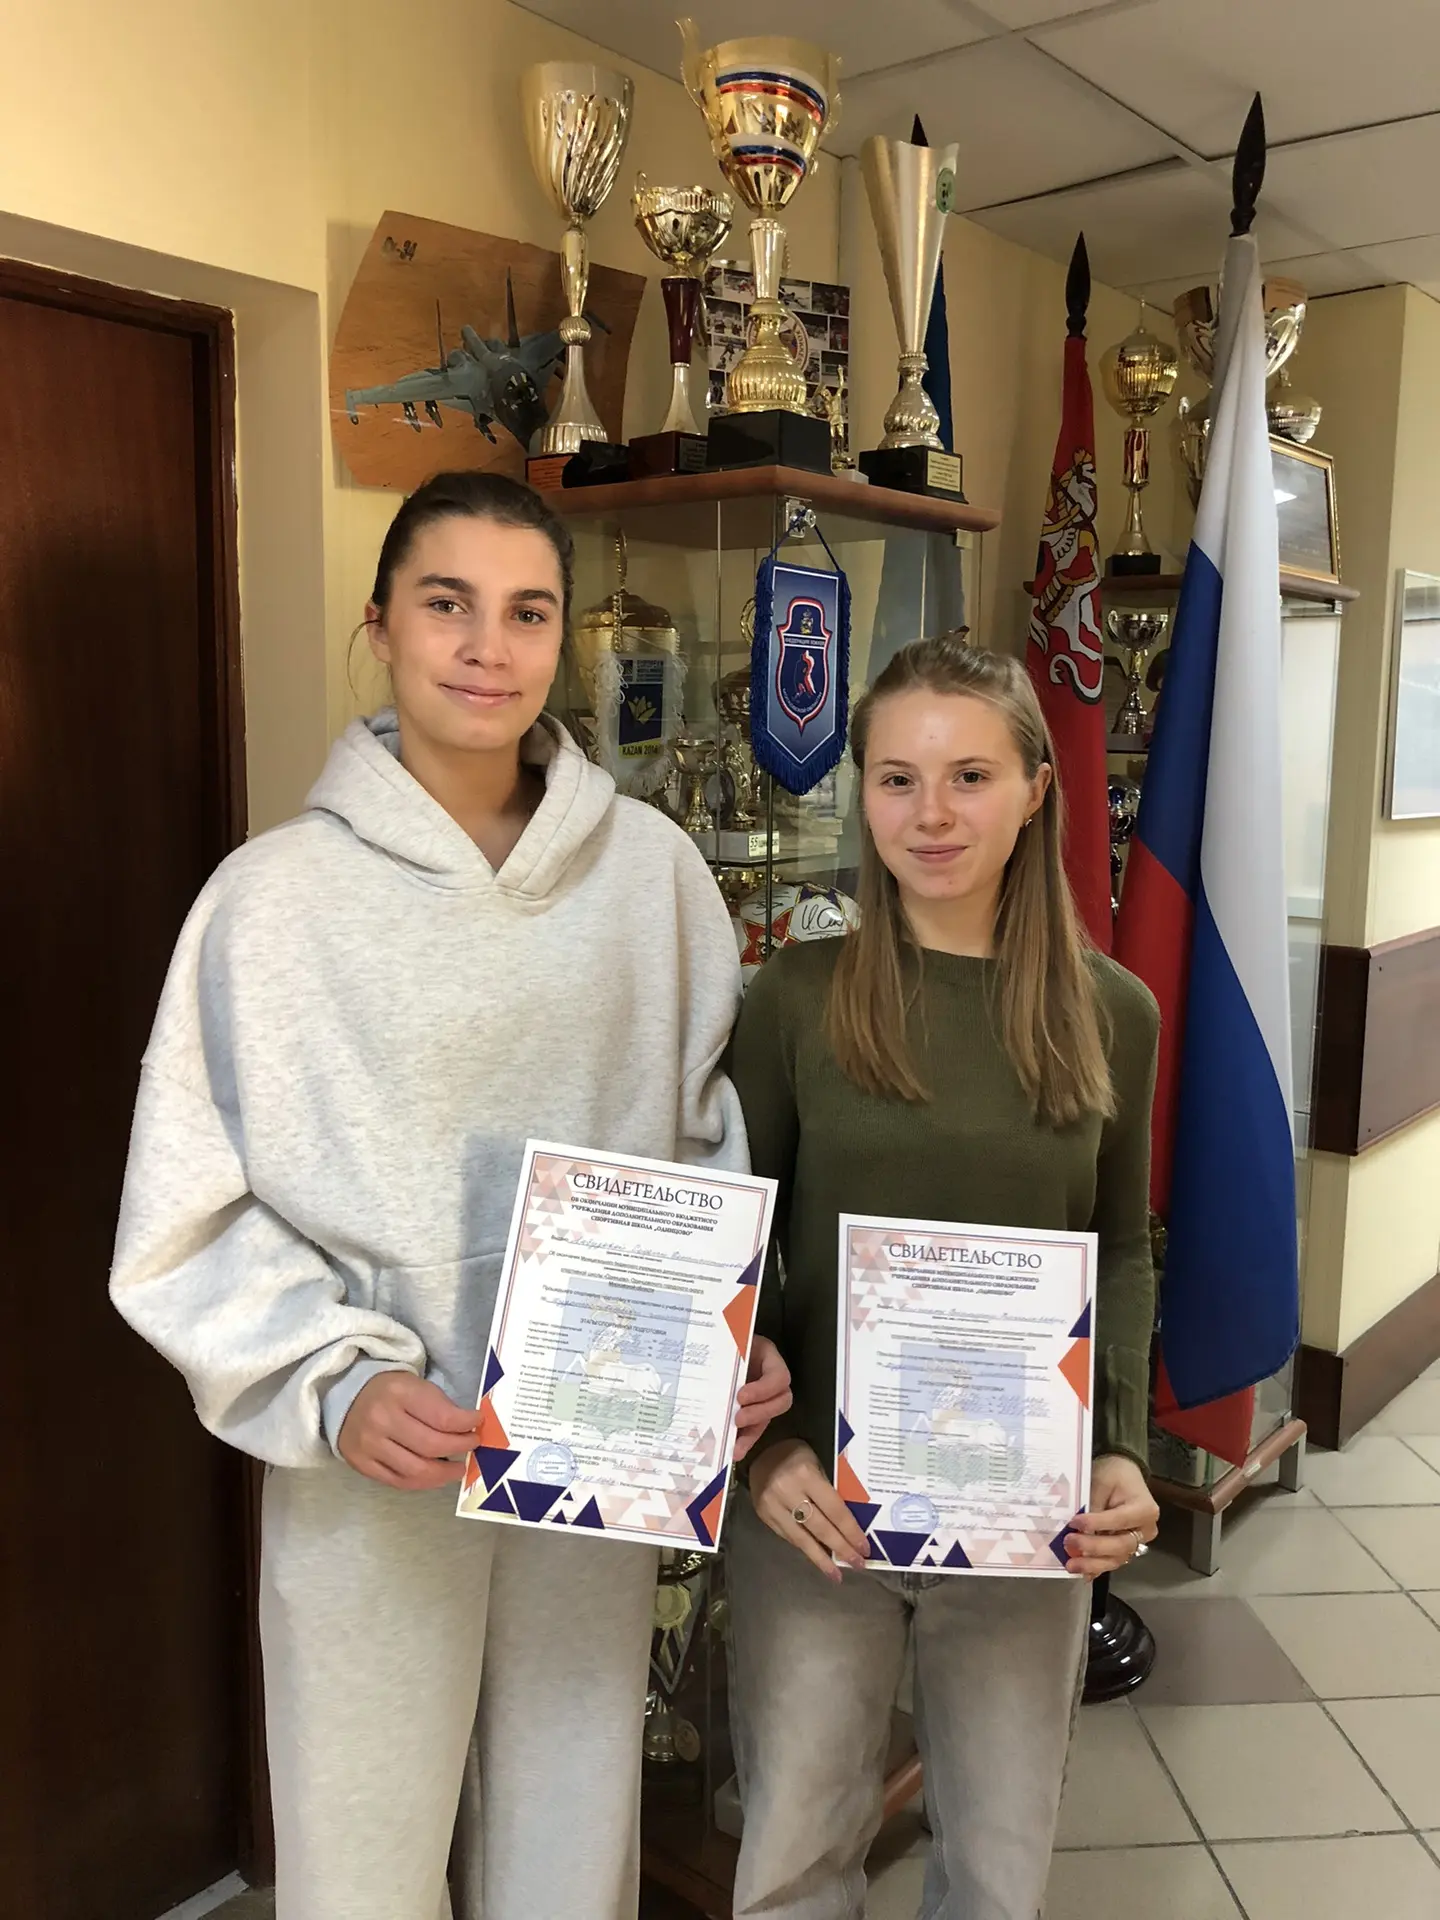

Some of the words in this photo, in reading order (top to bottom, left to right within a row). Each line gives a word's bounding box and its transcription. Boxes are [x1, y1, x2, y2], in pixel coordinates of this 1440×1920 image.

[622, 745, 642, 756] KAZAN
[573, 1172, 723, 1210] СВИДЕТЕЛЬСТВО
[571, 1204, 611, 1215] УЧРЕЖДЕНИЯ
[612, 1210, 672, 1225] ДОПОЛНИТЕЛЬНОГО
[672, 1220, 714, 1232] ОБРАЗОВАНИЯ
[580, 1197, 618, 1209] ОКОНЧАНИИ
[618, 1203, 675, 1218] МУНИЦИПАЛЬНОГО
[676, 1212, 718, 1225] БЮДЖЕТНОГО
[590, 1216, 630, 1226] СПОРТИВНАЯ
[630, 1222, 652, 1230] ШКОЛА
[889, 1242, 1042, 1269] СВИДЕТЕЛЬСТВО
